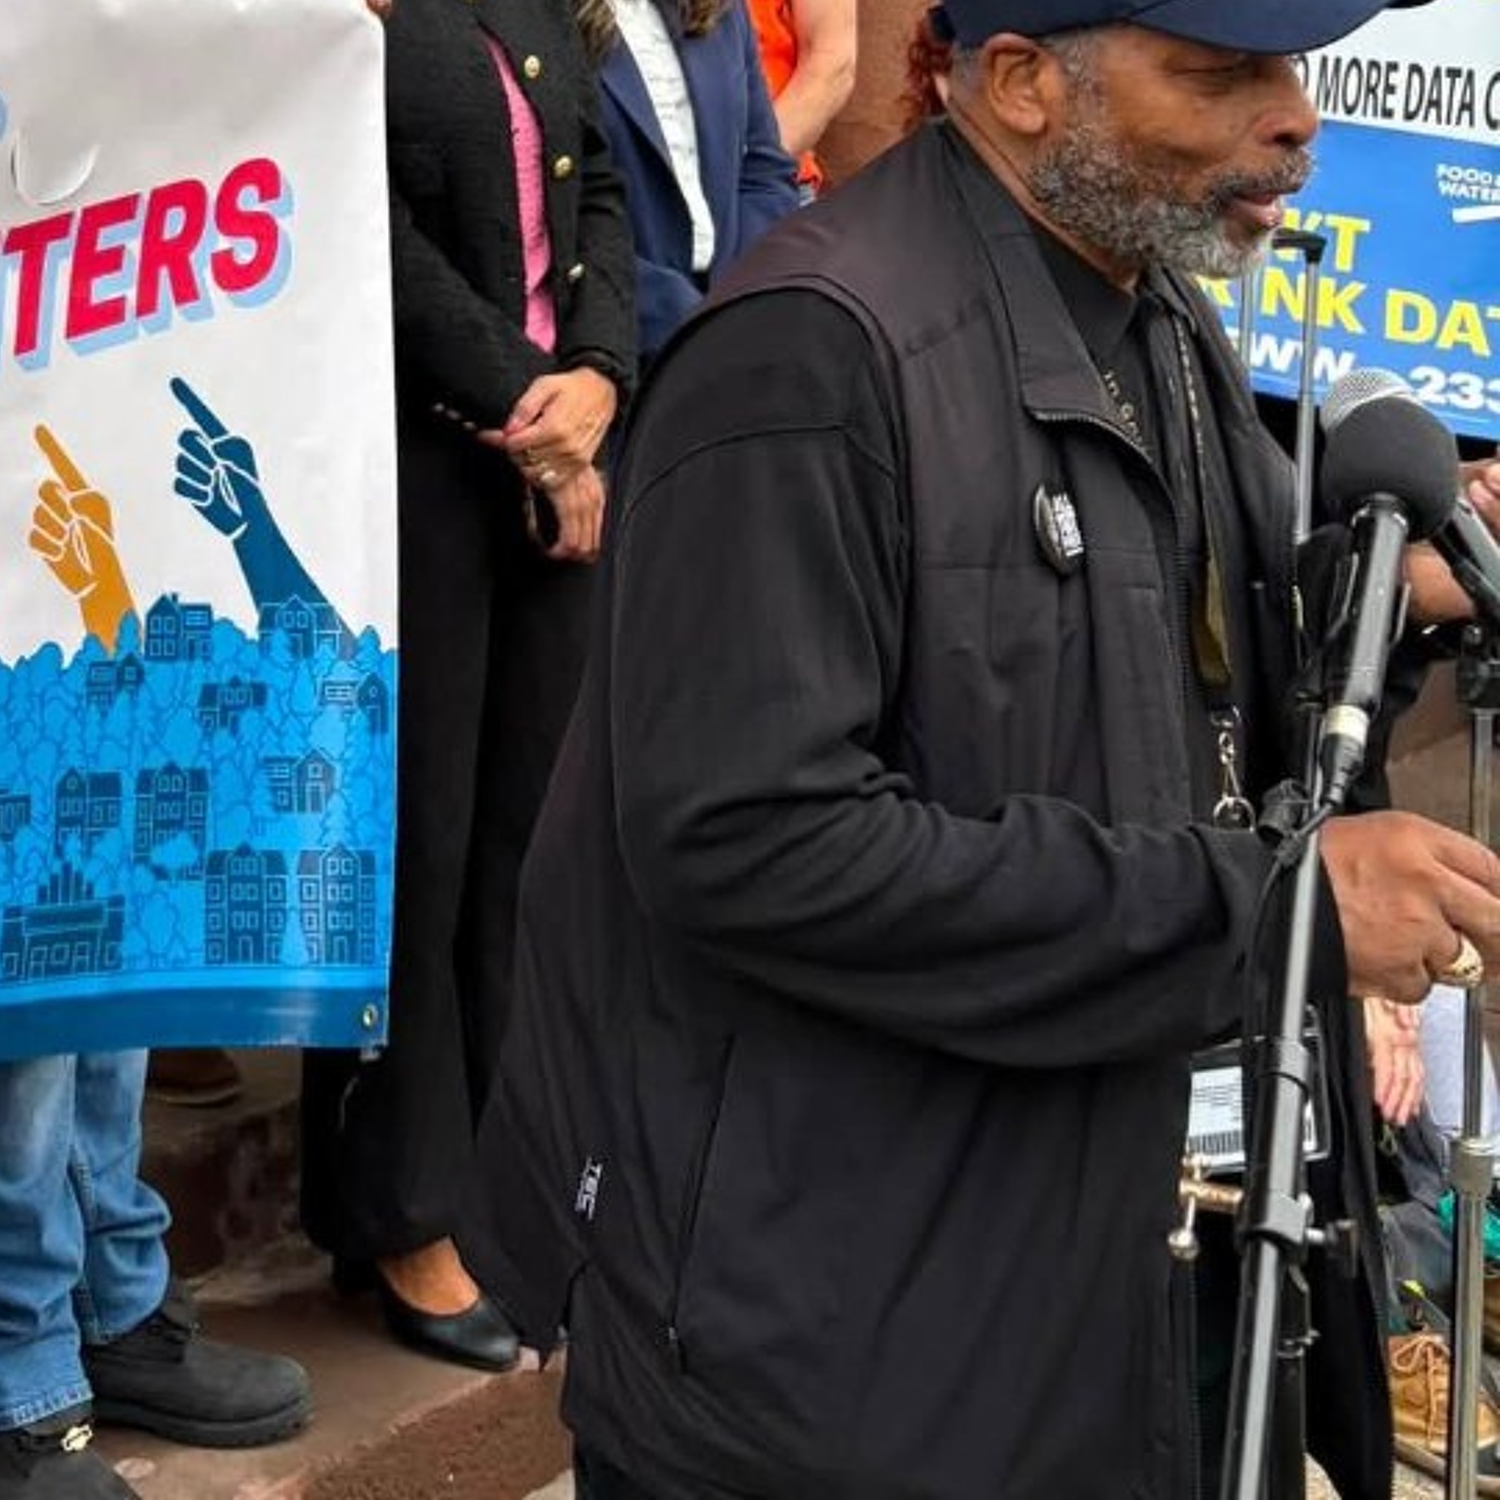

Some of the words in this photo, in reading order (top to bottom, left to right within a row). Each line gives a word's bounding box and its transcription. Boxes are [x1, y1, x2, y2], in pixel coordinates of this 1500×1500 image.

[1316, 55, 1399, 119] MORE
[1403, 63, 1476, 127] DATA
[1384, 288, 1500, 358] DA
